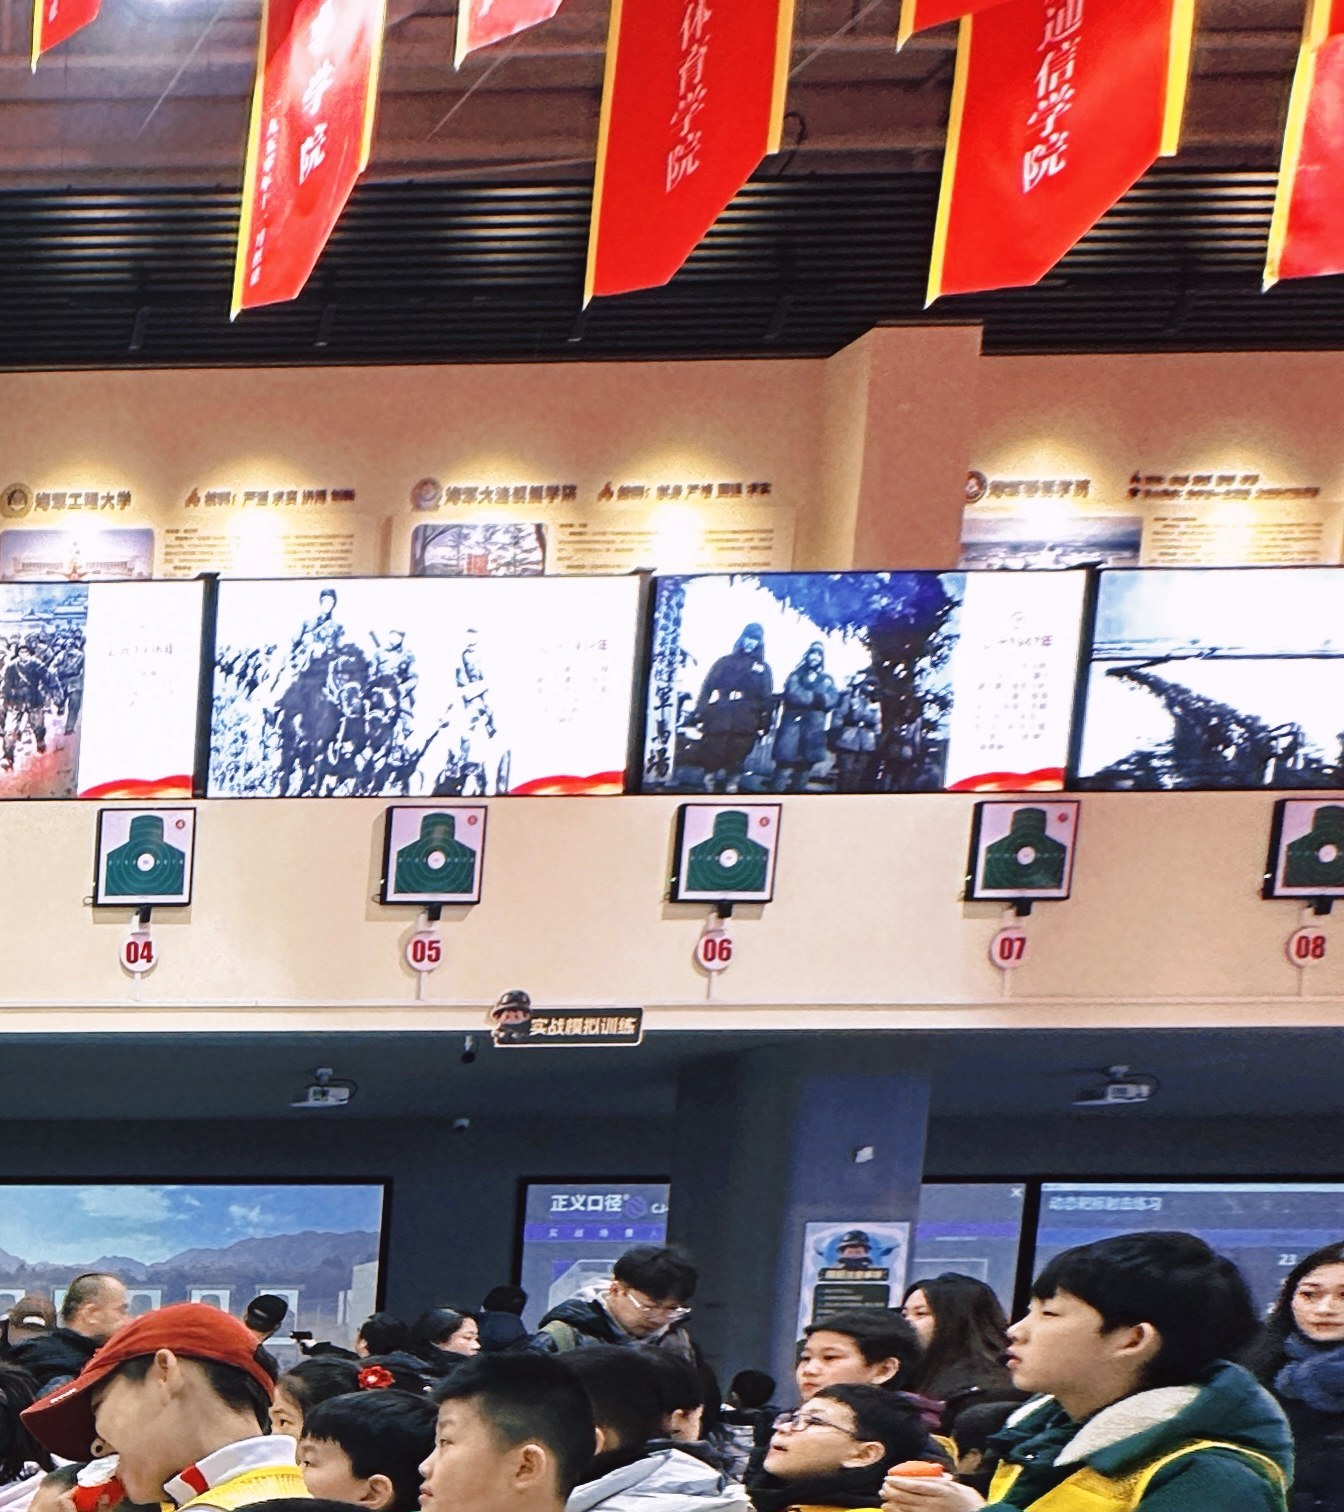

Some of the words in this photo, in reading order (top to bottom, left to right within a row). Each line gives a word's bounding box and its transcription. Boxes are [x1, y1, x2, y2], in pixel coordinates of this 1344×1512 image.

[124, 940, 153, 965] 04
[412, 938, 441, 964] 05
[701, 937, 732, 963] 06
[998, 936, 1027, 961] 07
[1294, 935, 1326, 960] 08
[529, 1016, 638, 1036] 实战模拟训练
[550, 1194, 624, 1212] 正义口径
[1277, 1253, 1297, 1266] 23
